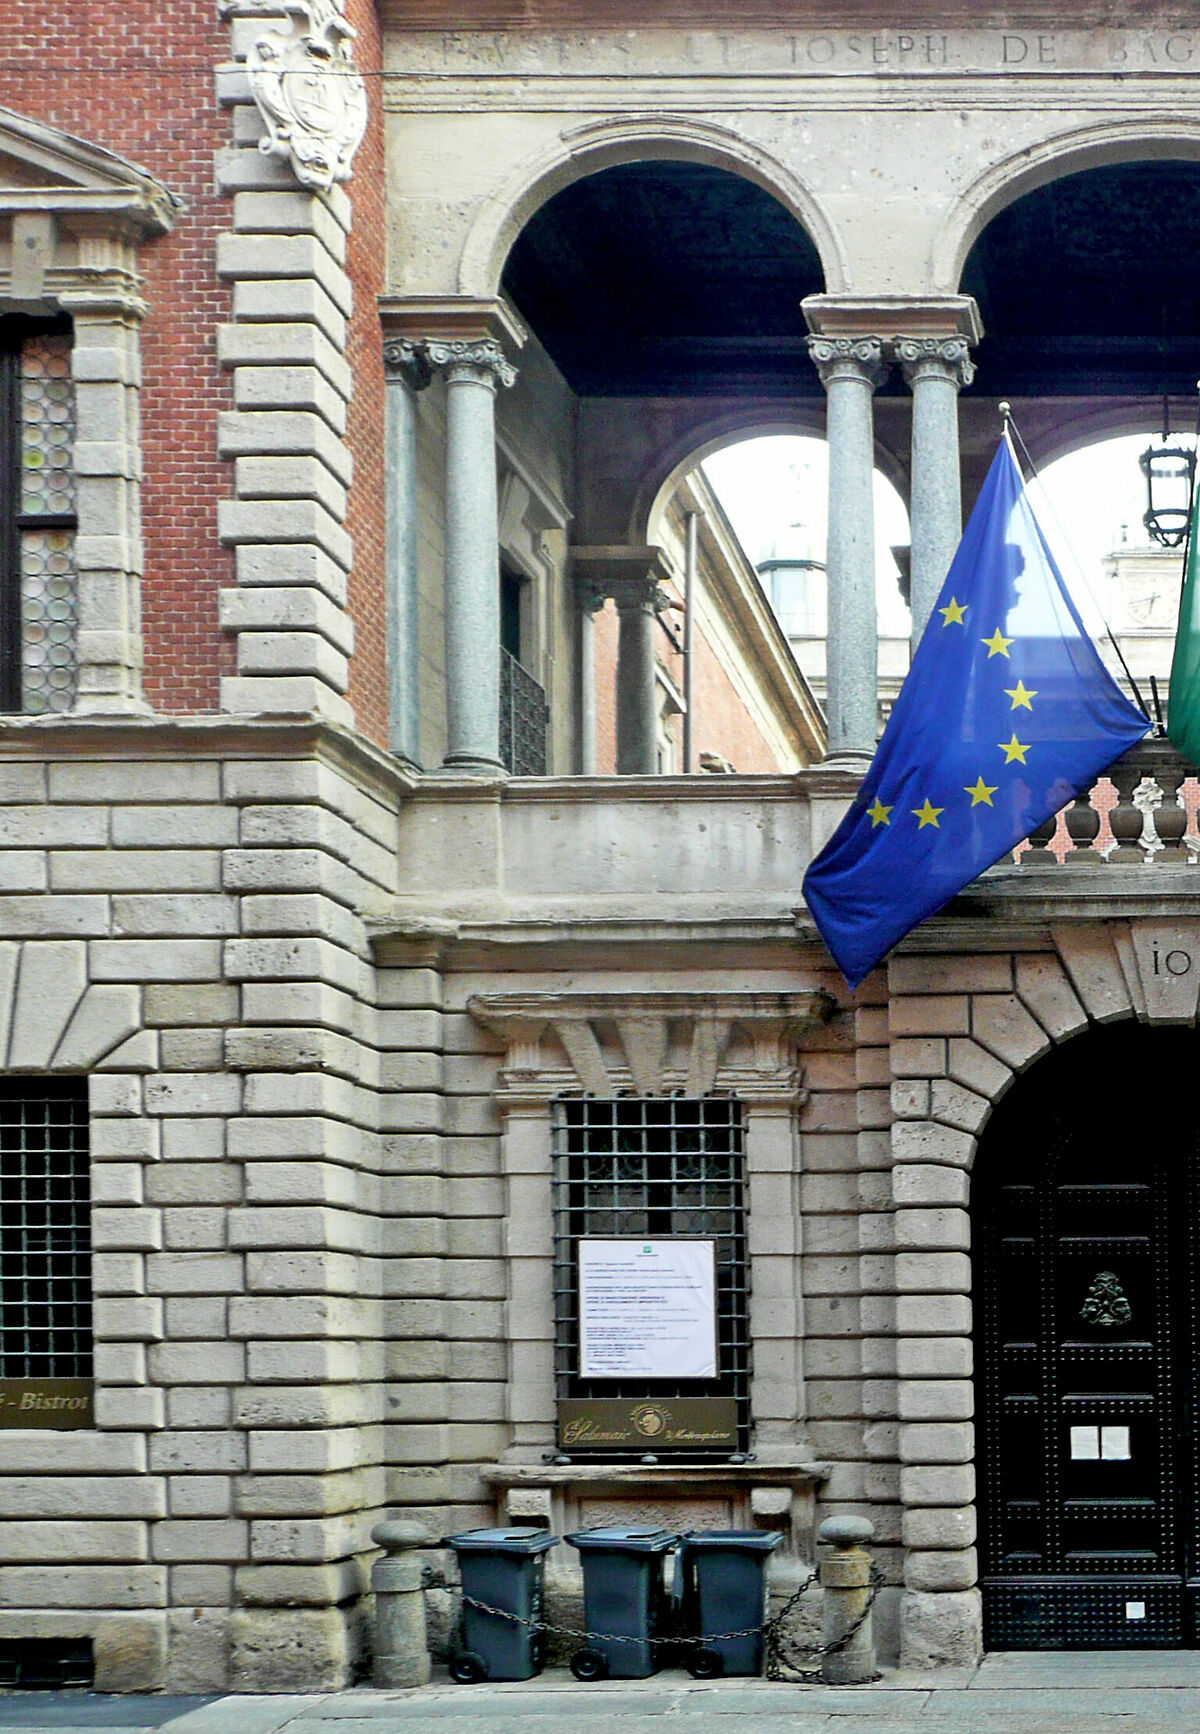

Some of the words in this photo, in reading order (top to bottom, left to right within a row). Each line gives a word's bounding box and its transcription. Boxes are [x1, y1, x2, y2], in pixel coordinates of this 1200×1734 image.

[786, 35, 951, 66] IOSEPH
[1001, 35, 1058, 64] DE
[20, 1392, 89, 1410] Bistrot
